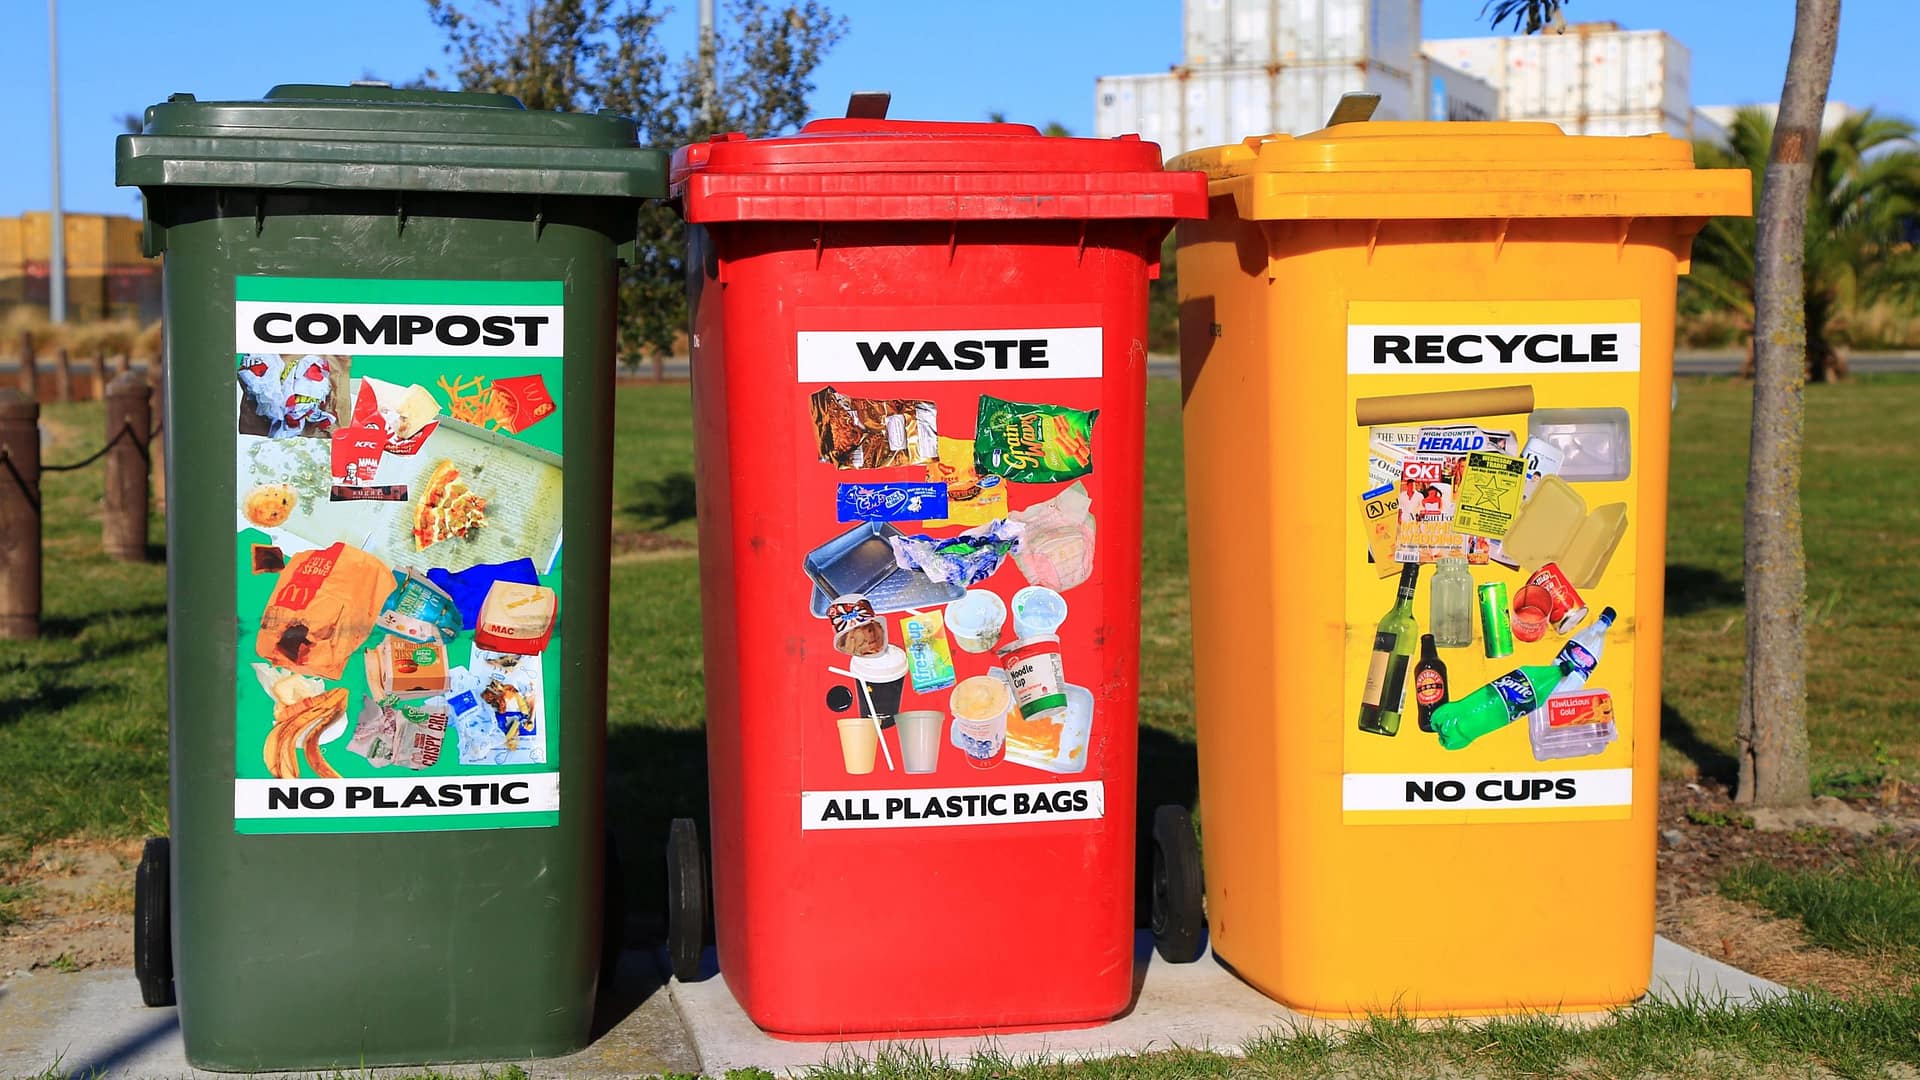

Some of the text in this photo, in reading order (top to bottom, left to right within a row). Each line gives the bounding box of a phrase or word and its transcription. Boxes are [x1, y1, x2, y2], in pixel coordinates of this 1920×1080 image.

[253, 312, 549, 346] COMPOST
[856, 339, 1049, 371] WASTE
[1373, 333, 1618, 364] RECYCLE
[354, 441, 377, 449] KFC
[1003, 424, 1039, 469] Grain
[1397, 433, 1418, 443] WEE
[1418, 436, 1484, 451] HERALD
[1405, 464, 1440, 479] OK!
[491, 624, 515, 636] MAC
[1011, 663, 1034, 680] Noodle
[1014, 678, 1026, 688] Cup
[1495, 675, 1532, 698] Sprite
[1561, 707, 1576, 716] Gold
[422, 735, 441, 767] CRISPY
[268, 782, 529, 810] NO PLASTIC
[1405, 778, 1577, 802] NO CUPS
[821, 789, 1089, 821] ALL PLASTIC BAGS
